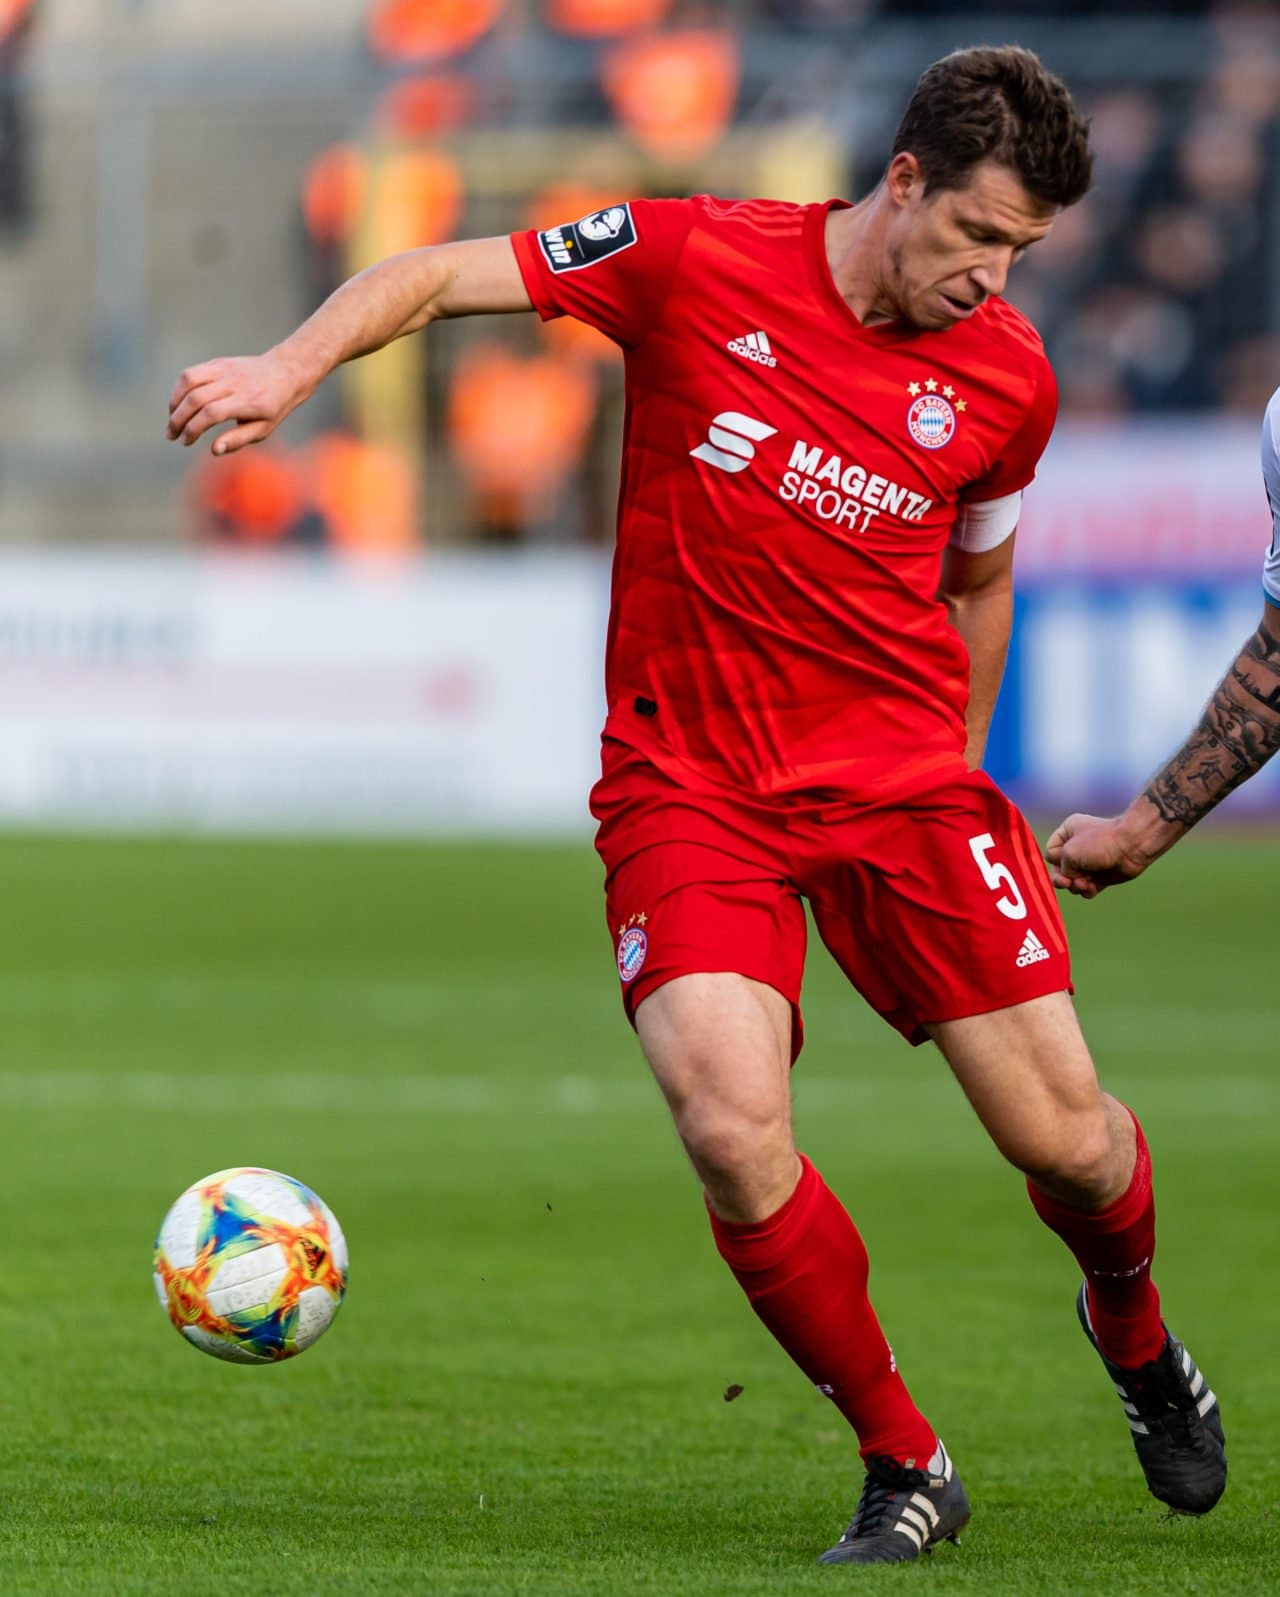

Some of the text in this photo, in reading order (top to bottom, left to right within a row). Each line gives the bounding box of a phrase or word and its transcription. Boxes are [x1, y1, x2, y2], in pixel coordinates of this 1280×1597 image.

[727, 341, 777, 368] adidas
[778, 471, 880, 533] SPORT
[787, 439, 933, 521] MAGENTA
[968, 833, 1028, 920] 5
[1016, 948, 1050, 967] adidas
